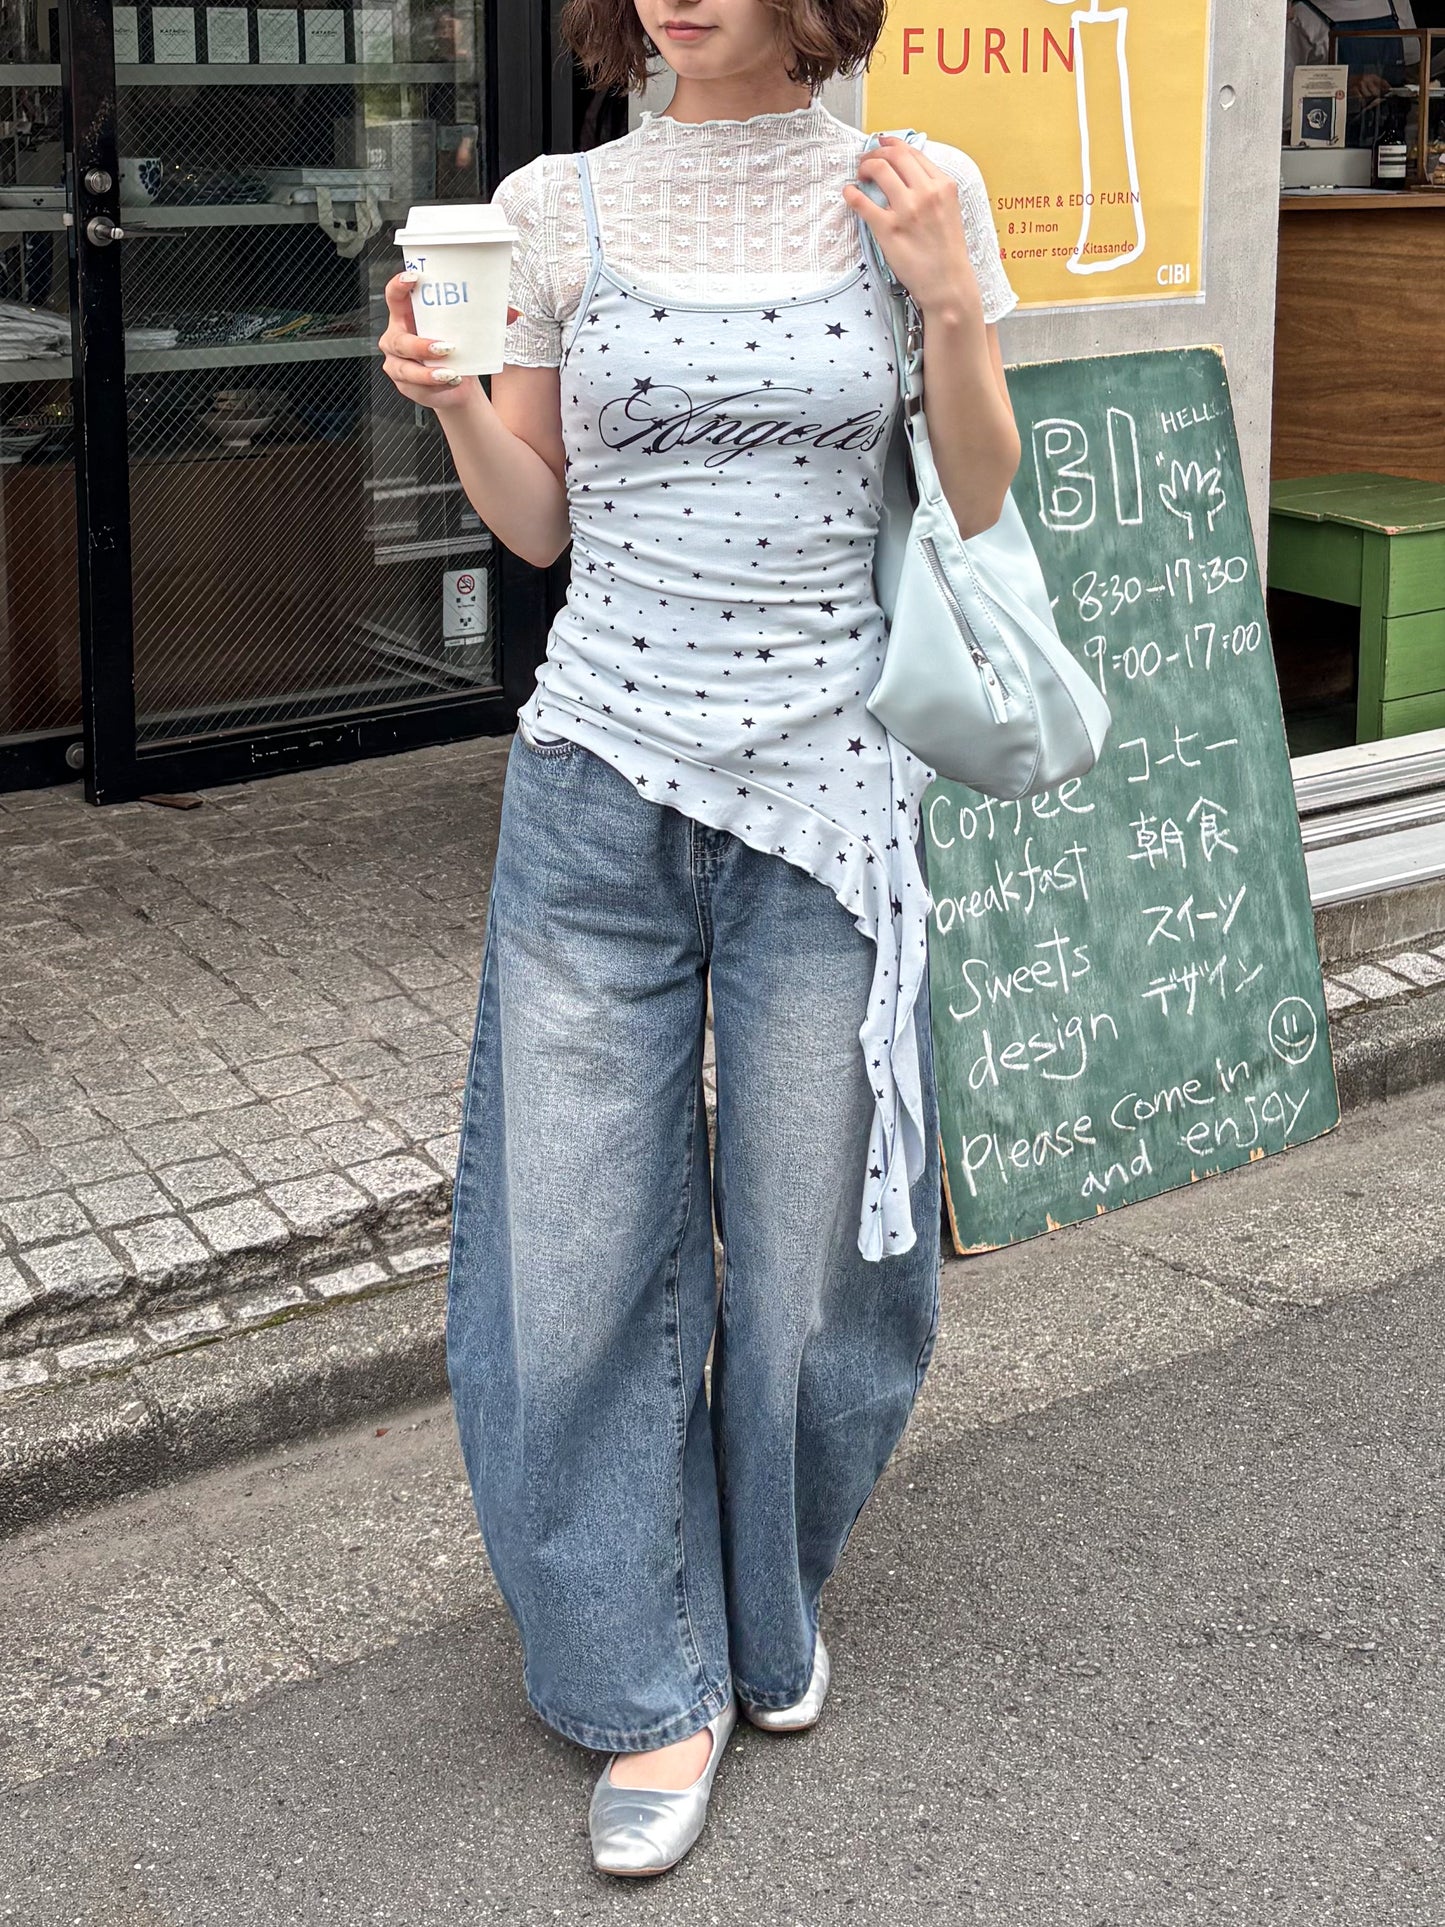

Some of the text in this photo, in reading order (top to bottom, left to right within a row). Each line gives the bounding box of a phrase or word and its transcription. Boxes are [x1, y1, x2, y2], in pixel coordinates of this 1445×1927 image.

[902, 27, 1075, 75] FURIN
[997, 192, 1140, 210] SUMMER & EDO FURIN
[1011, 248, 1048, 260] corner
[1051, 245, 1079, 257] store
[1083, 240, 1135, 255] Kitasando
[1156, 262, 1190, 286] CIBI
[421, 281, 469, 306] CIBI
[1118, 725, 1239, 783] コーヒー
[1126, 796, 1239, 870] 朝食
[929, 836, 1089, 936] breakfast
[1141, 882, 1247, 945] スイーツ
[1141, 954, 1264, 1017] デザイン
[968, 1012, 1119, 1090] design
[1215, 1057, 1250, 1093] in
[1080, 1138, 1154, 1198] and
